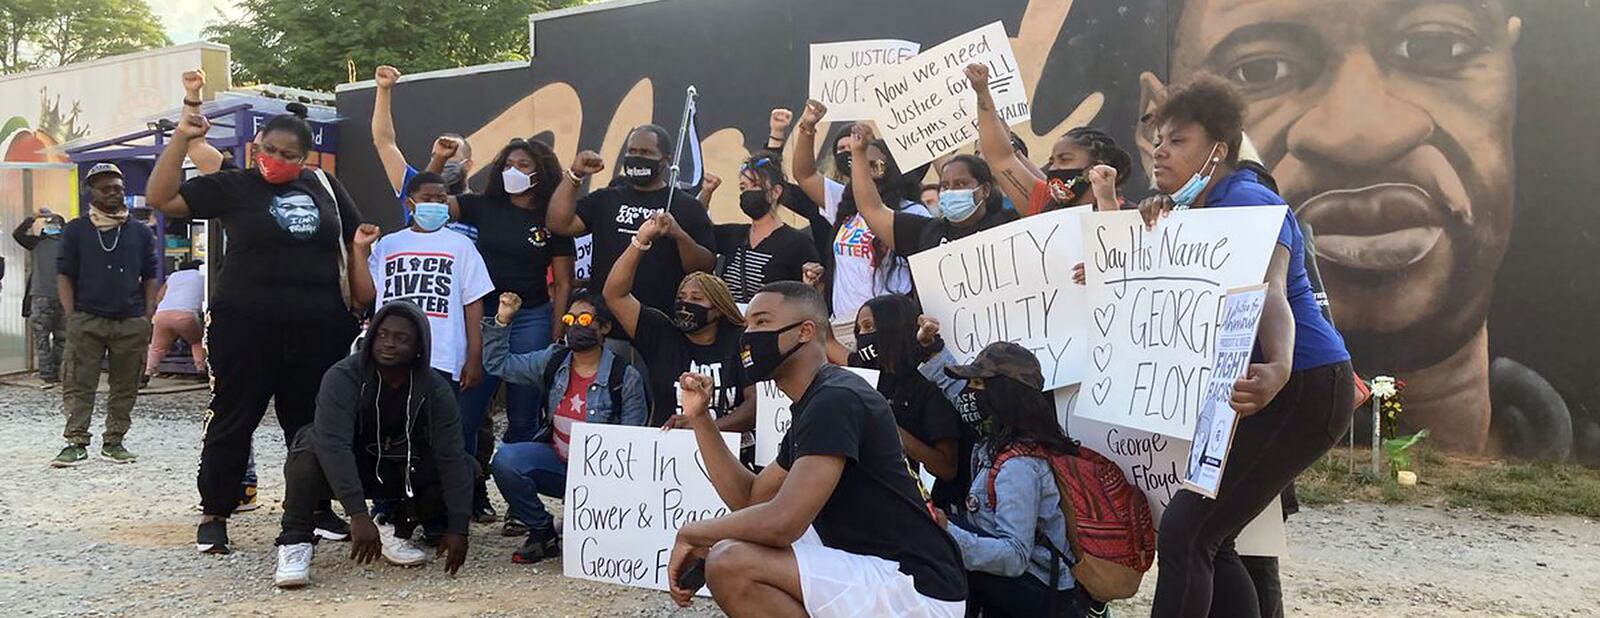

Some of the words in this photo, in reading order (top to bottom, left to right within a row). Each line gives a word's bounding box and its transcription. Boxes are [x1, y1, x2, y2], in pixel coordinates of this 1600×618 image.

[820, 55, 838, 71] NO
[844, 47, 914, 69] JUSTICE
[874, 79, 909, 107] Now
[944, 35, 992, 69] need
[821, 79, 846, 104] NO
[888, 92, 943, 130] Justice
[946, 77, 968, 96] for
[953, 98, 968, 121] of
[926, 125, 972, 158] POLICE
[385, 257, 454, 277] BLCK
[938, 224, 1059, 302] GUILTY
[1095, 225, 1127, 300] Say
[1130, 224, 1153, 272] His
[1159, 223, 1231, 271] Name
[383, 273, 451, 298] LIVES
[953, 288, 1058, 355] GUILTY
[1213, 351, 1249, 378] FIGHT
[1205, 381, 1232, 402] RACIS
[584, 434, 638, 481] Rest
[653, 441, 682, 486] In
[1107, 428, 1168, 472] George
[1131, 461, 1183, 509] Floyd
[573, 485, 632, 531] Power
[637, 503, 653, 529] &
[581, 537, 648, 584] George
